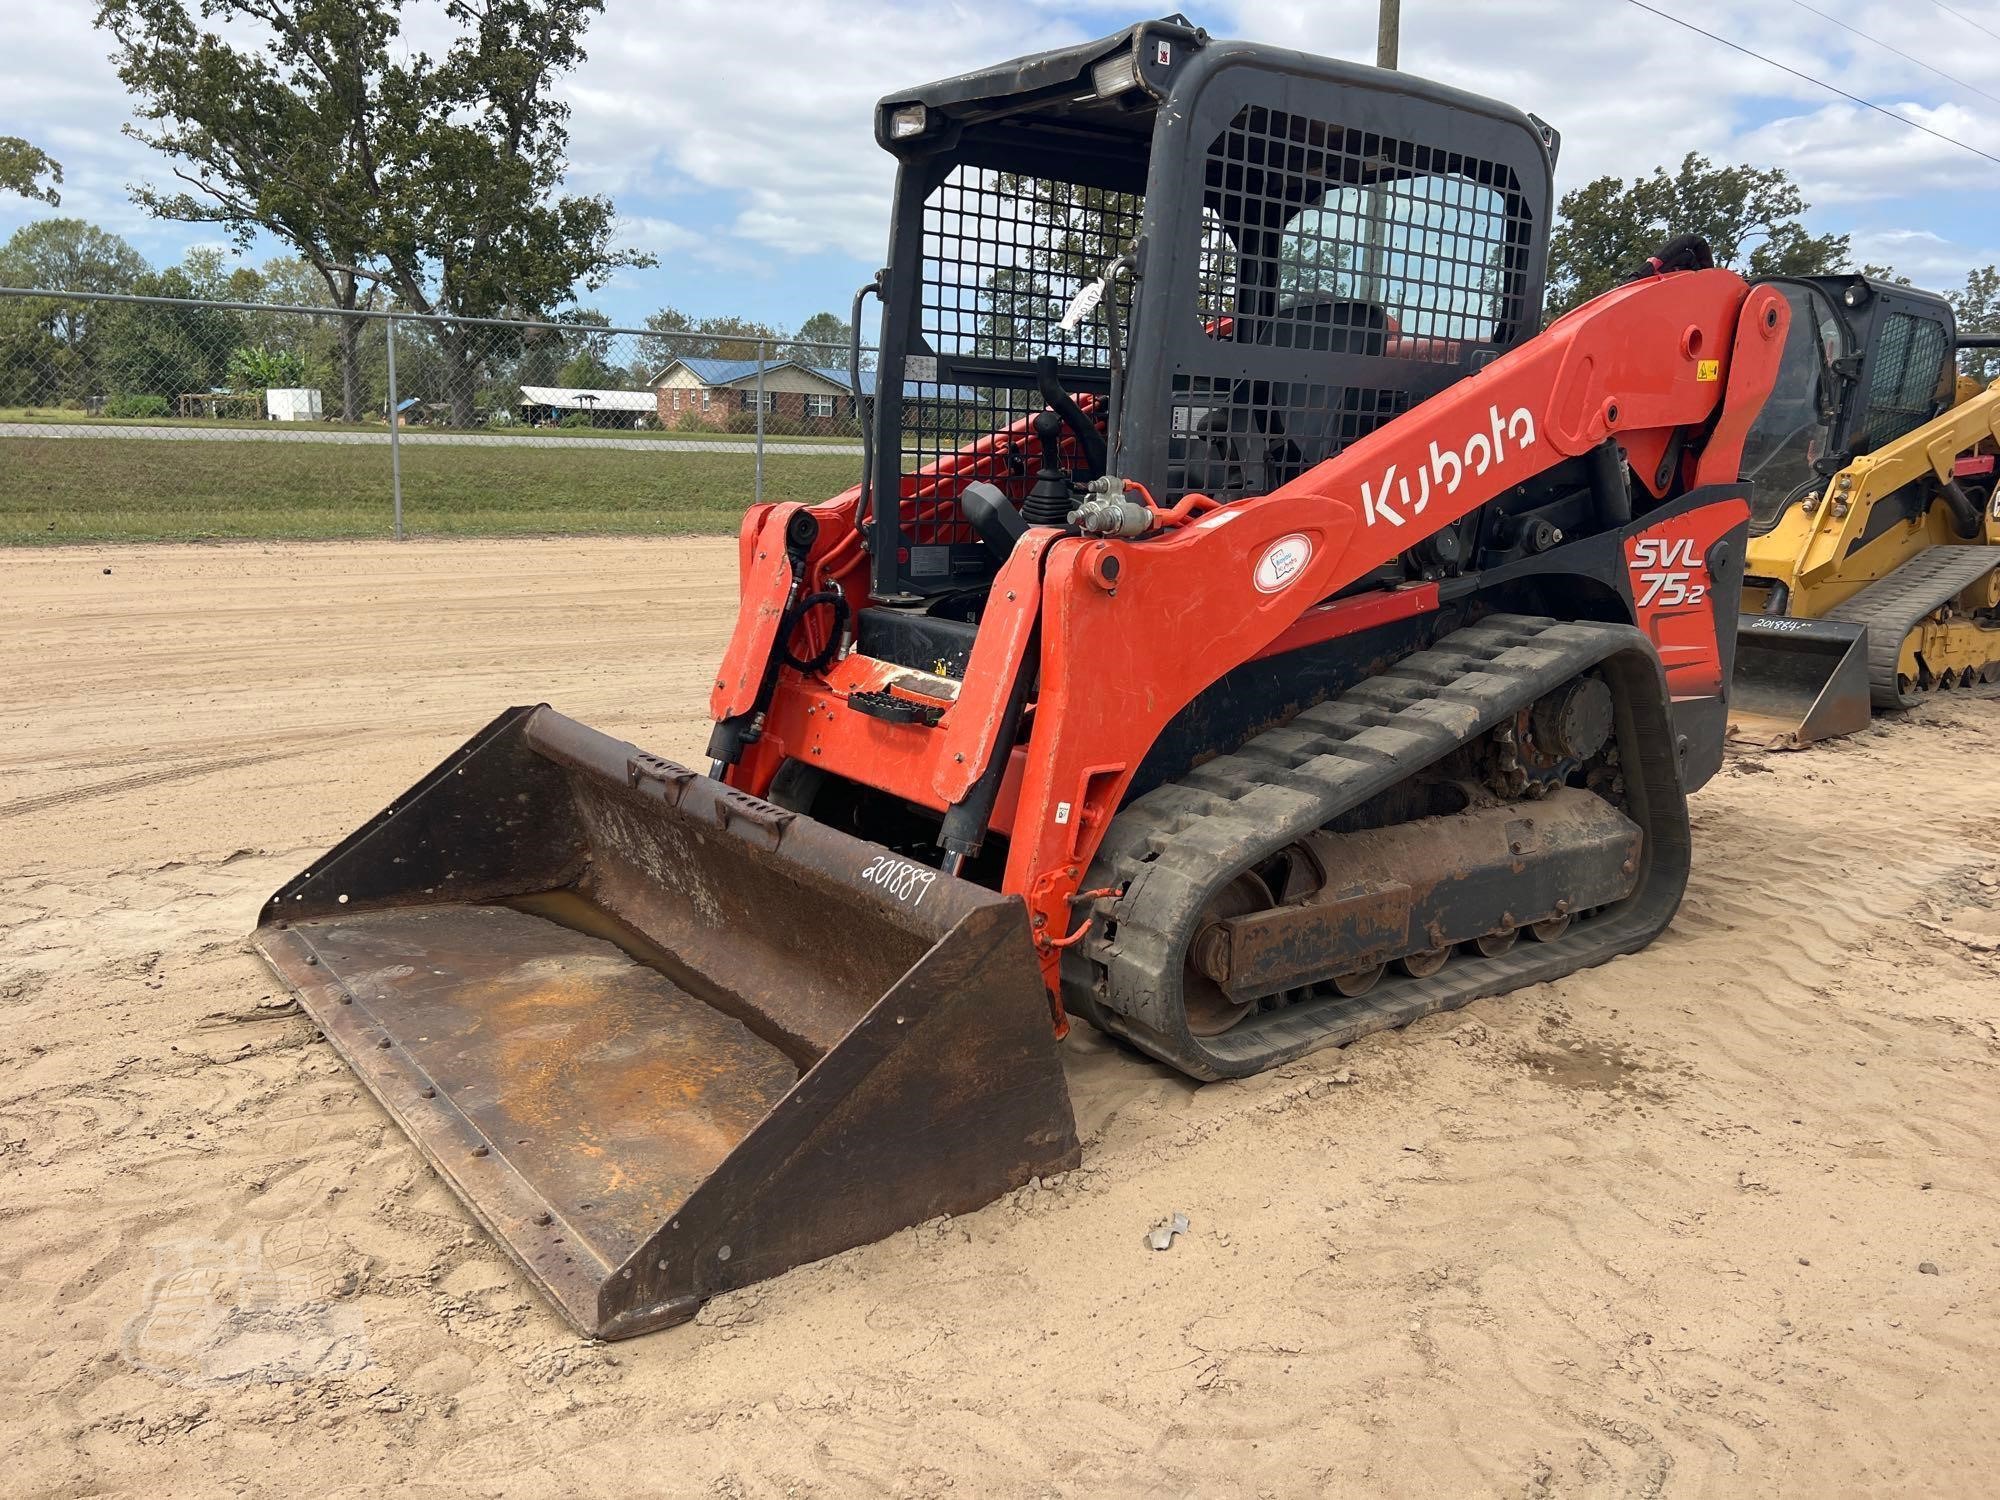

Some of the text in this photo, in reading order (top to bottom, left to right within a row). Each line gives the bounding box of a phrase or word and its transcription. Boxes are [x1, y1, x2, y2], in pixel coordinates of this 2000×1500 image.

[1360, 404, 1536, 527] Kubota
[1629, 538, 1703, 569] SVL
[861, 856, 937, 907] 201889
